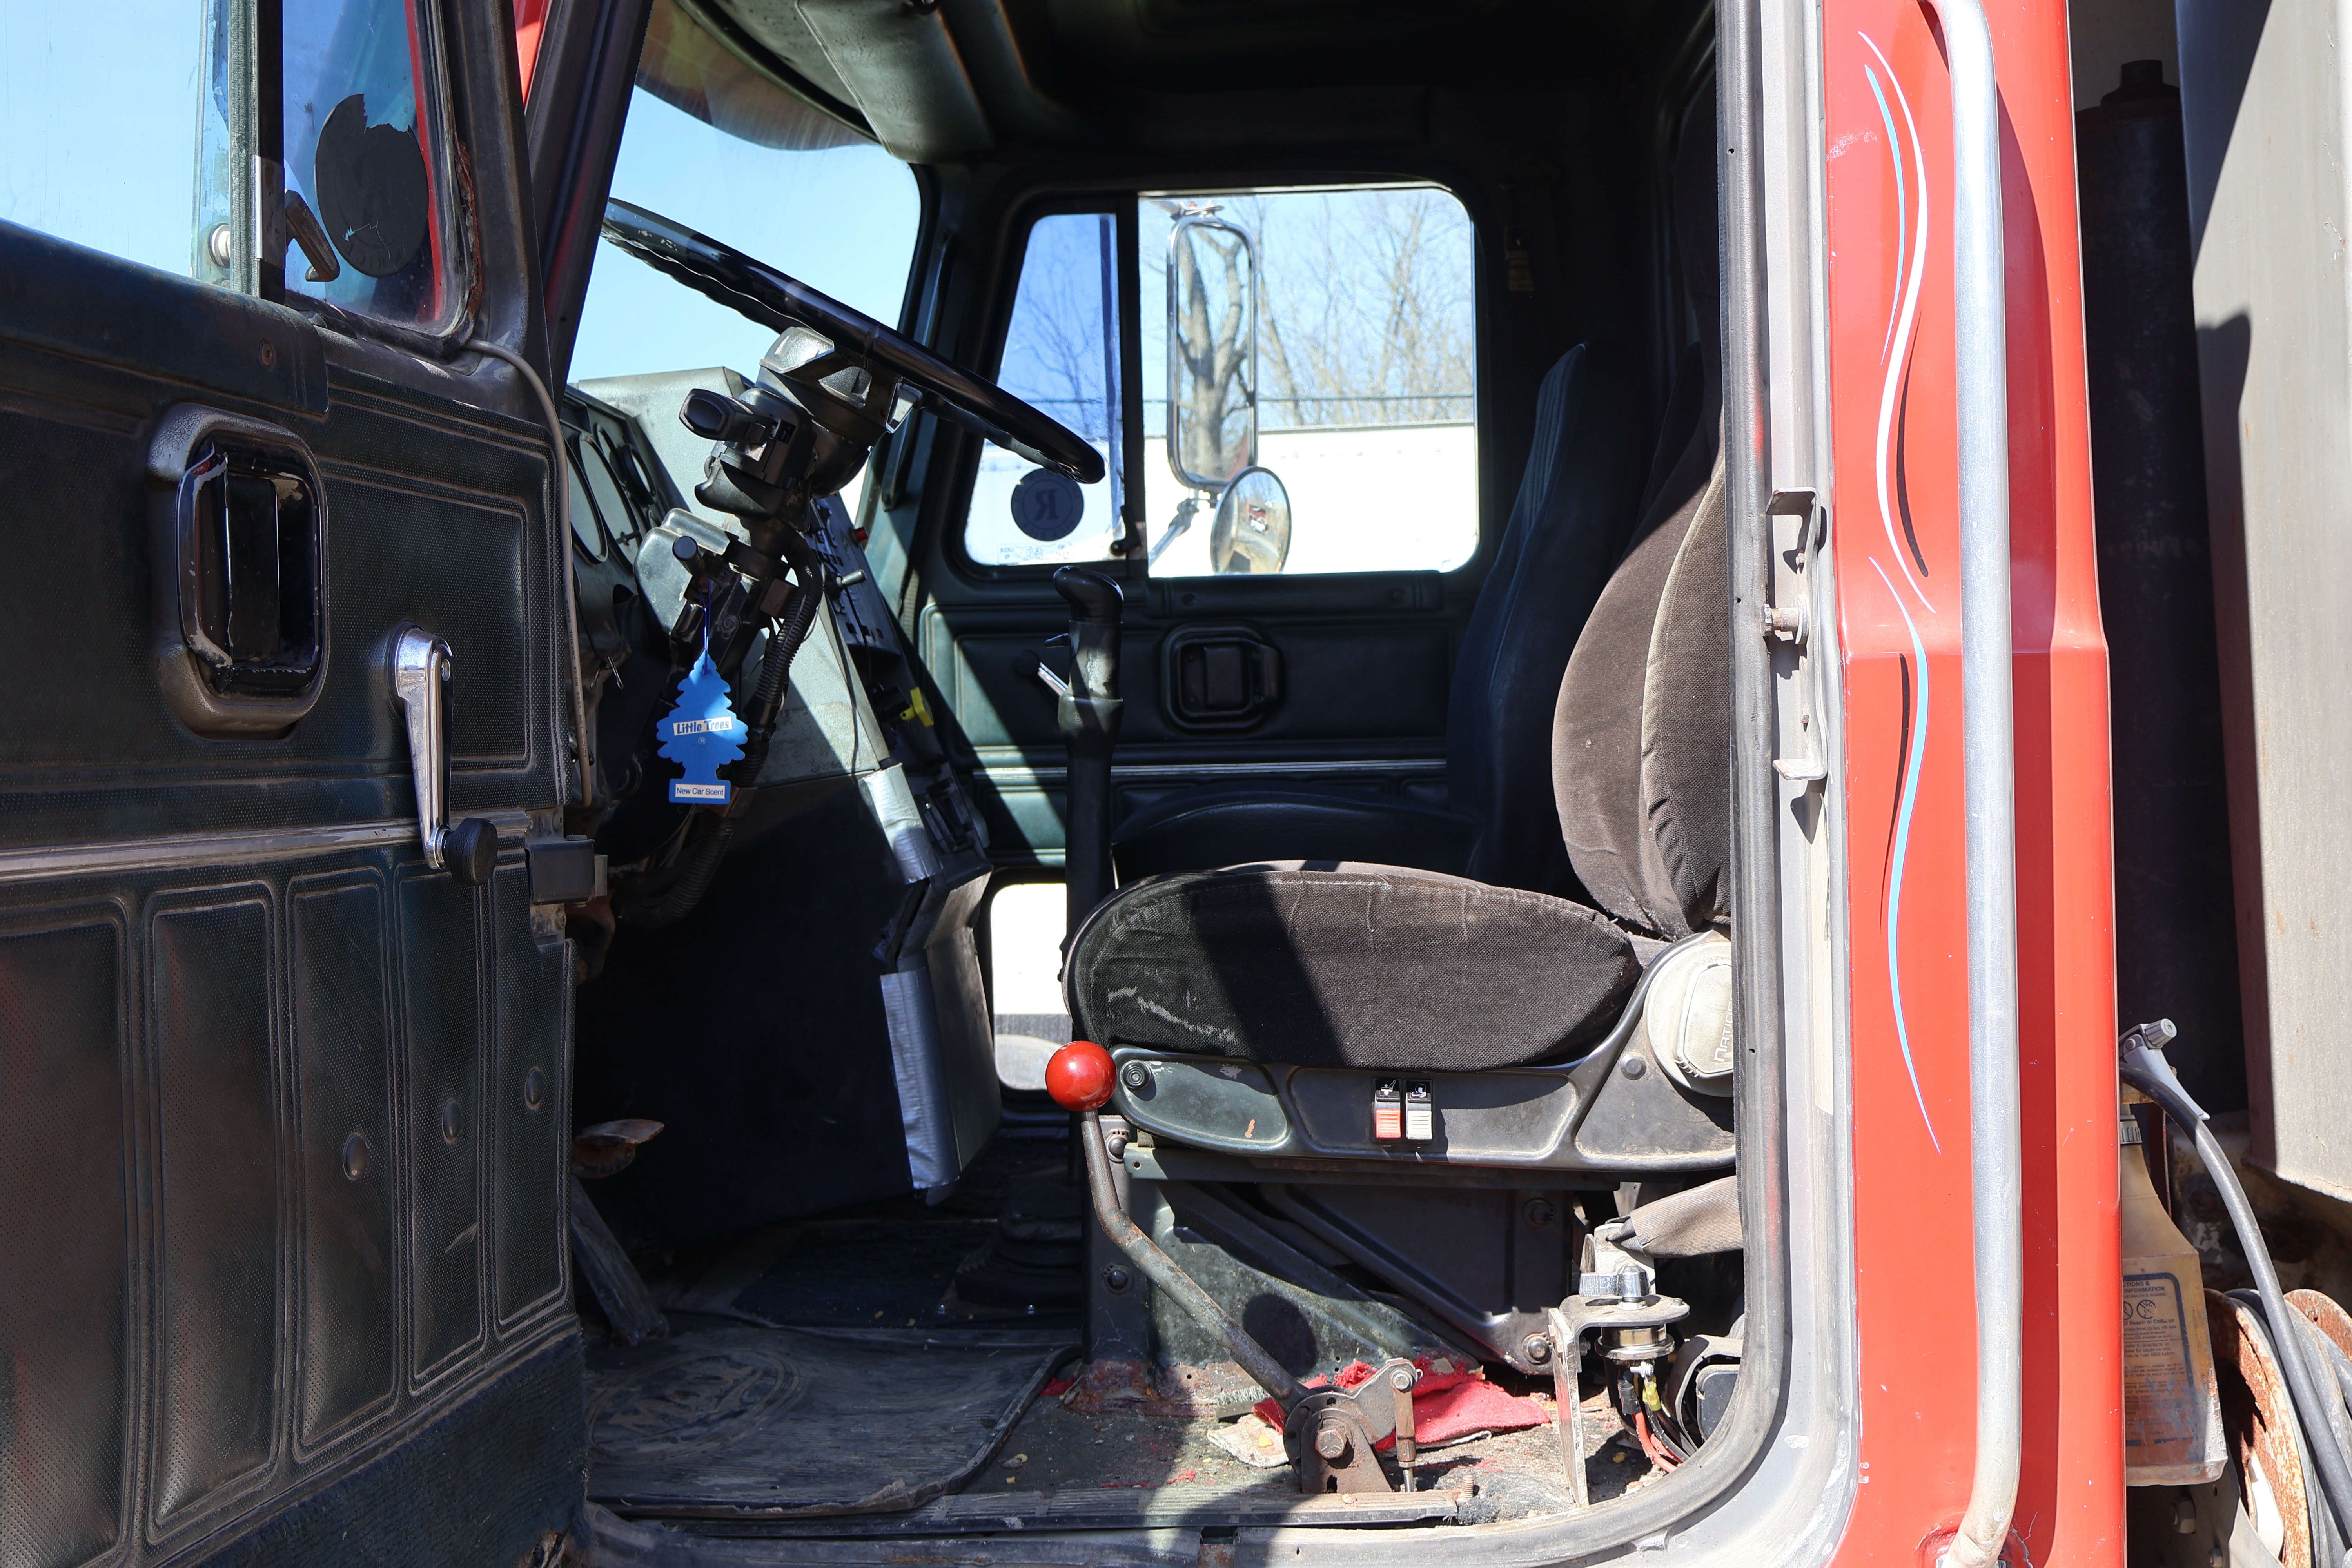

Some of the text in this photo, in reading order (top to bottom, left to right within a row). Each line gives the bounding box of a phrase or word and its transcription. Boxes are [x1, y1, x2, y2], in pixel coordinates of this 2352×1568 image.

[677, 720, 730, 734] Little Trees
[1714, 990, 1732, 1062] NATIO
